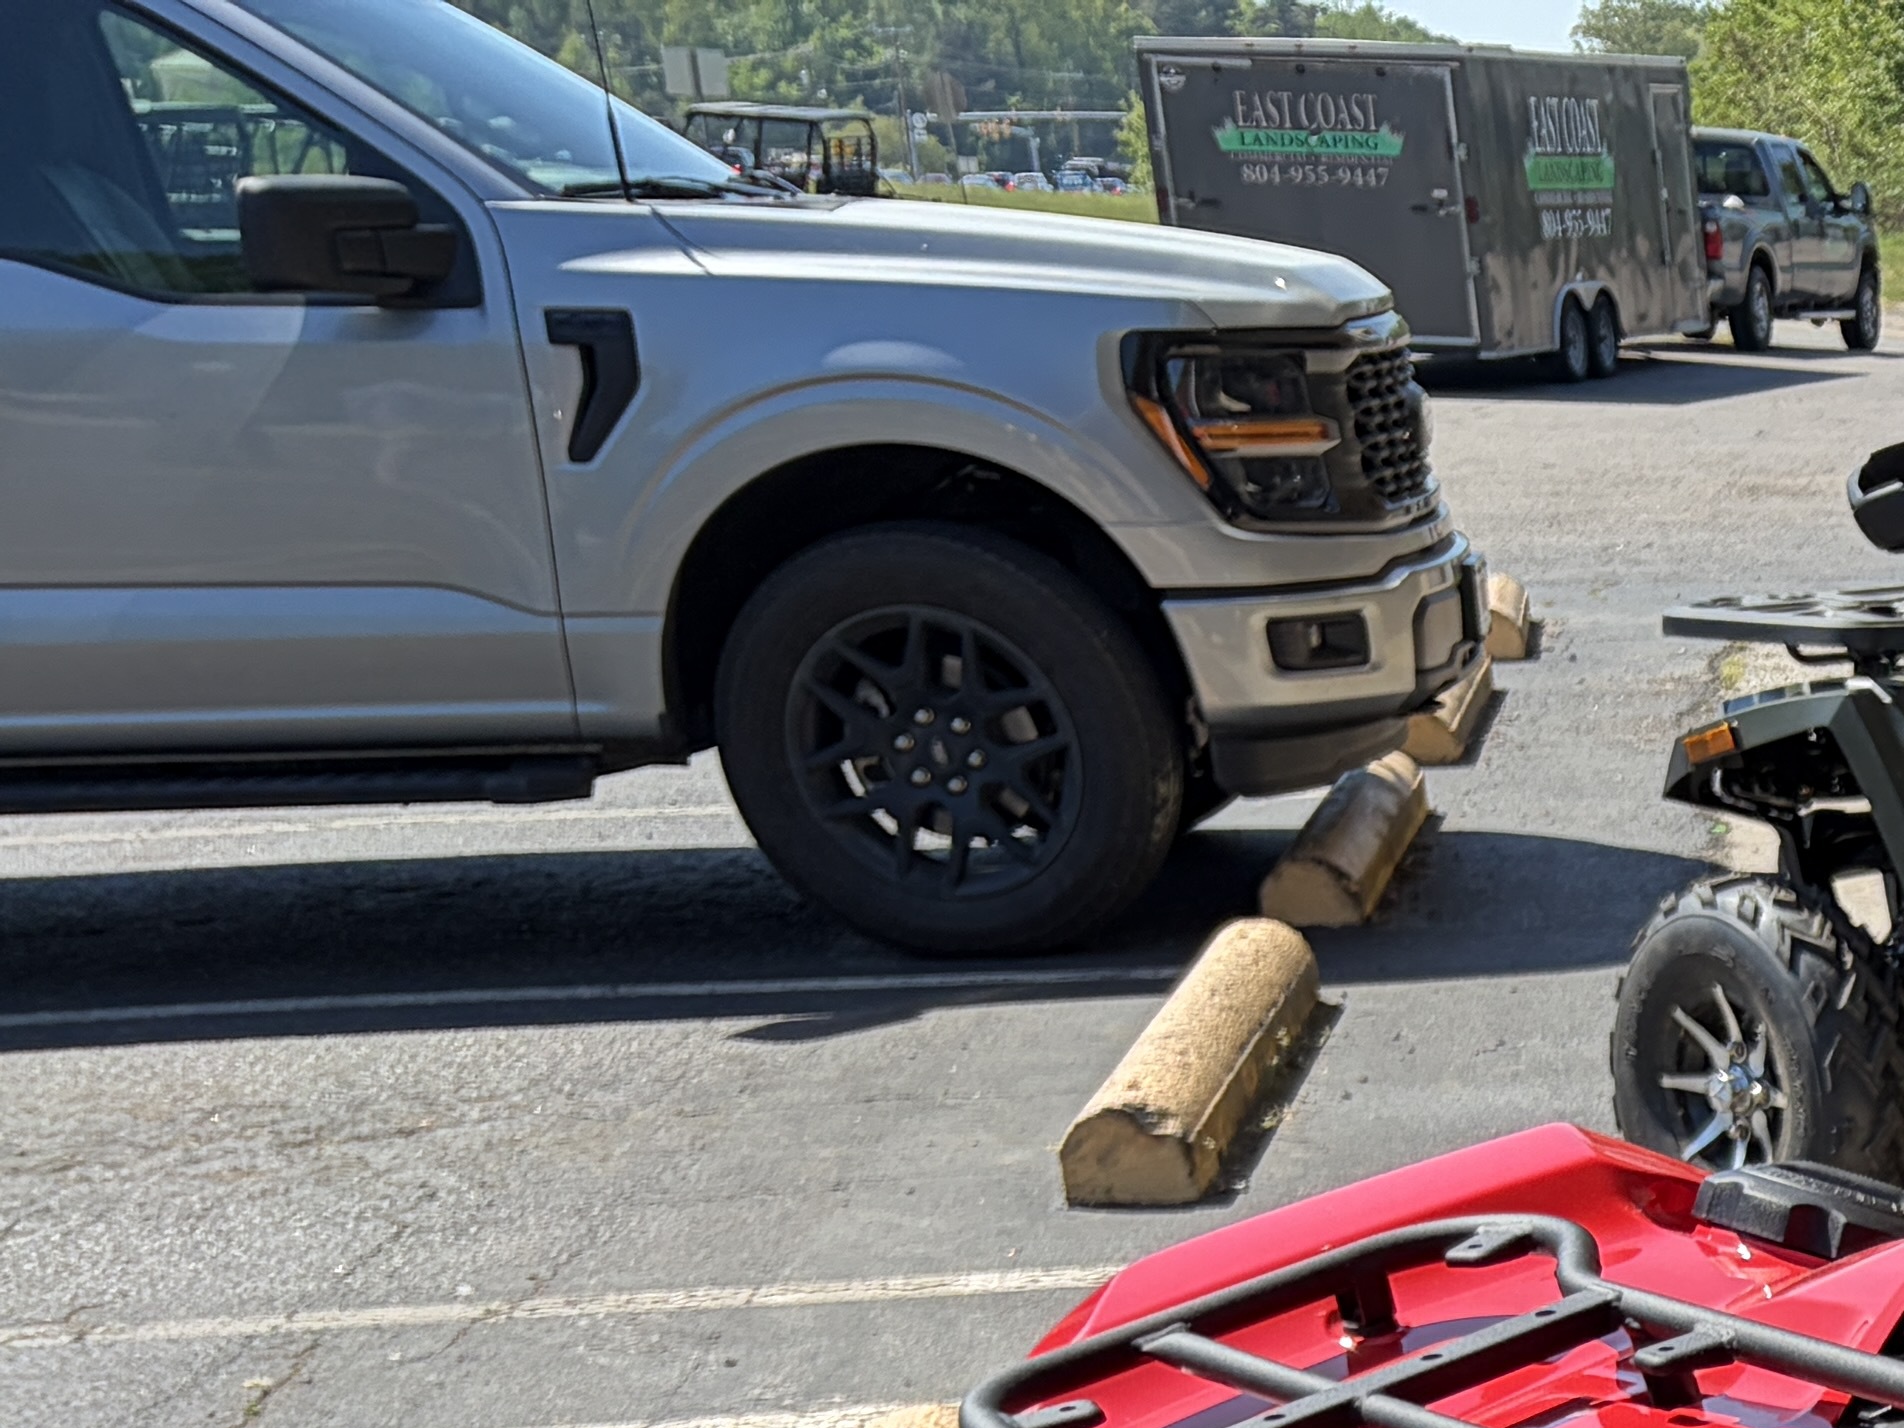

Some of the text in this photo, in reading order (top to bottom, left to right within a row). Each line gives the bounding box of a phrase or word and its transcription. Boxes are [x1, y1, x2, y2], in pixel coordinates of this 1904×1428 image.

[1233, 90, 1377, 131] EAST COAST
[1530, 96, 1601, 153] EAST COAST
[1239, 131, 1379, 150] LANDSCAPING
[1241, 163, 1389, 188] 804-955-9447
